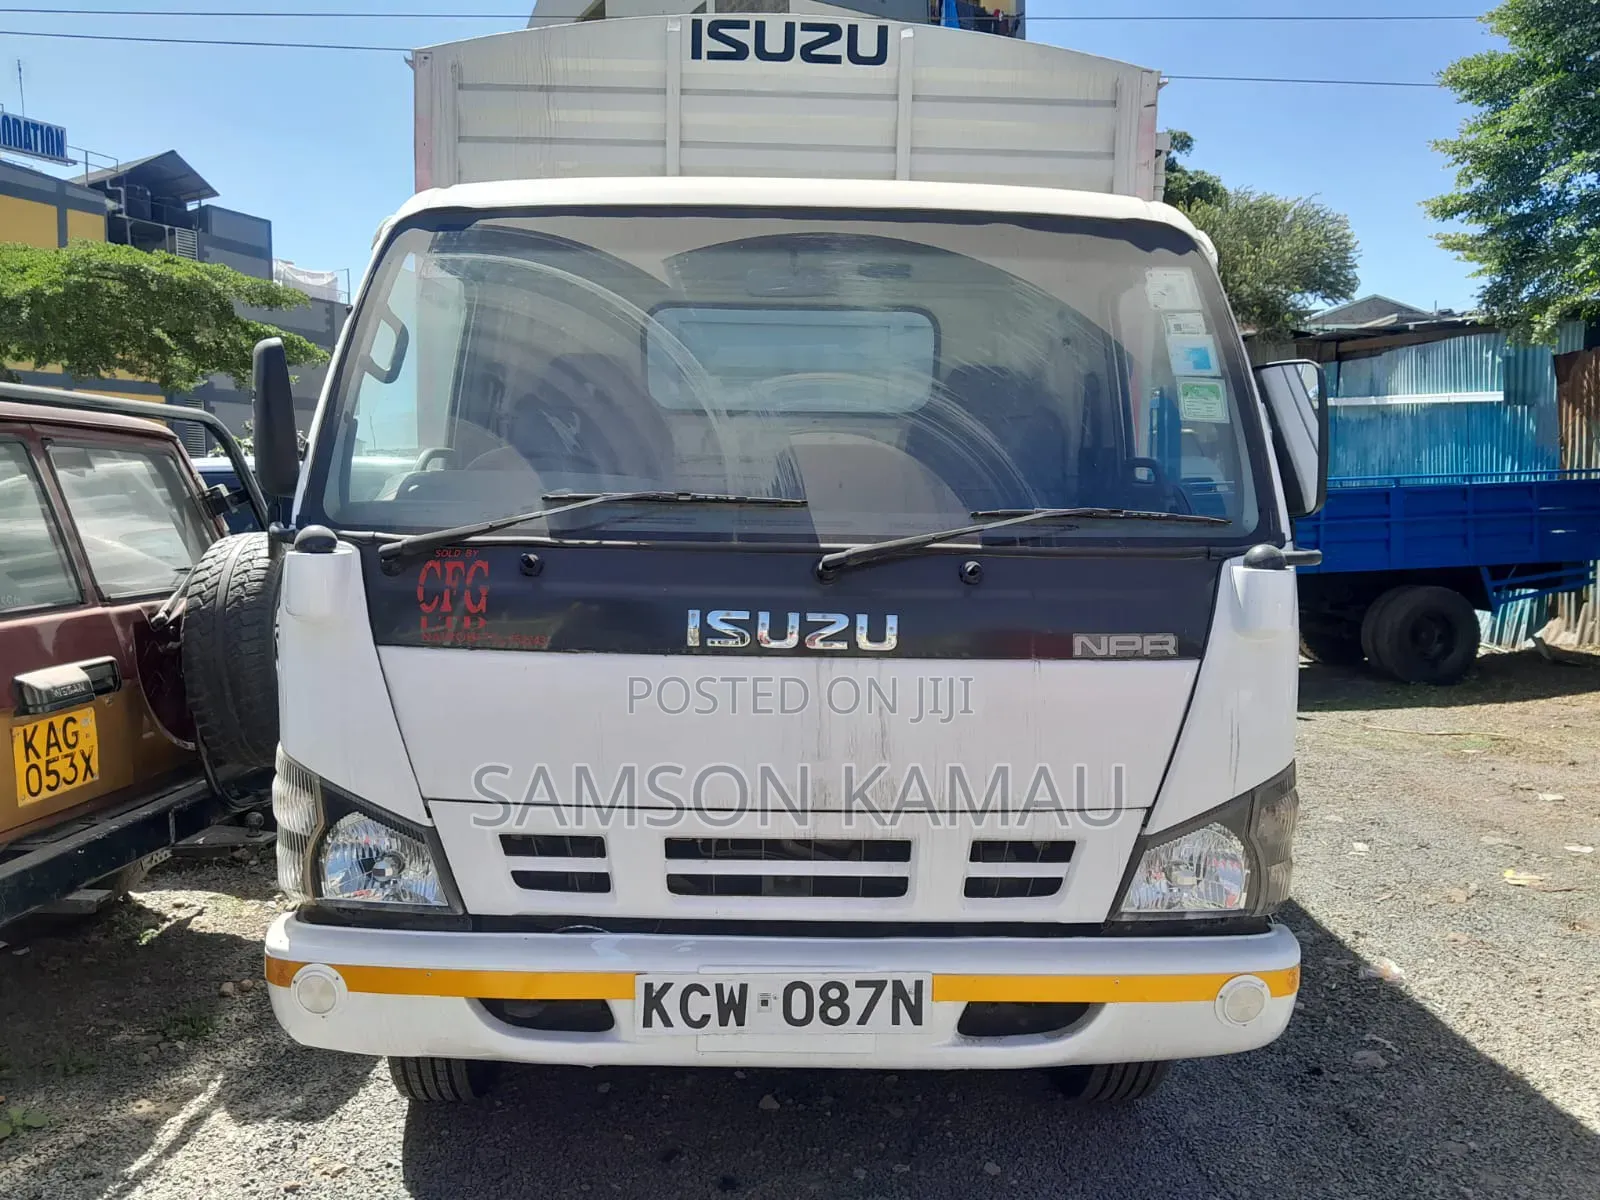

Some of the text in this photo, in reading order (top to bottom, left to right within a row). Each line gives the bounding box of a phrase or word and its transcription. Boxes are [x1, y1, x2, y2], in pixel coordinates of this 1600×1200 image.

[690, 18, 889, 65] ISUZU
[0, 114, 65, 159] ODATION
[435, 549, 480, 558] SOLD BY
[416, 559, 489, 614] CFG
[686, 609, 899, 651] ISUZU
[1073, 634, 1179, 657] NPR
[23, 716, 79, 763] KAG
[25, 745, 94, 797] 053X
[642, 980, 924, 1029] KCW 087N
